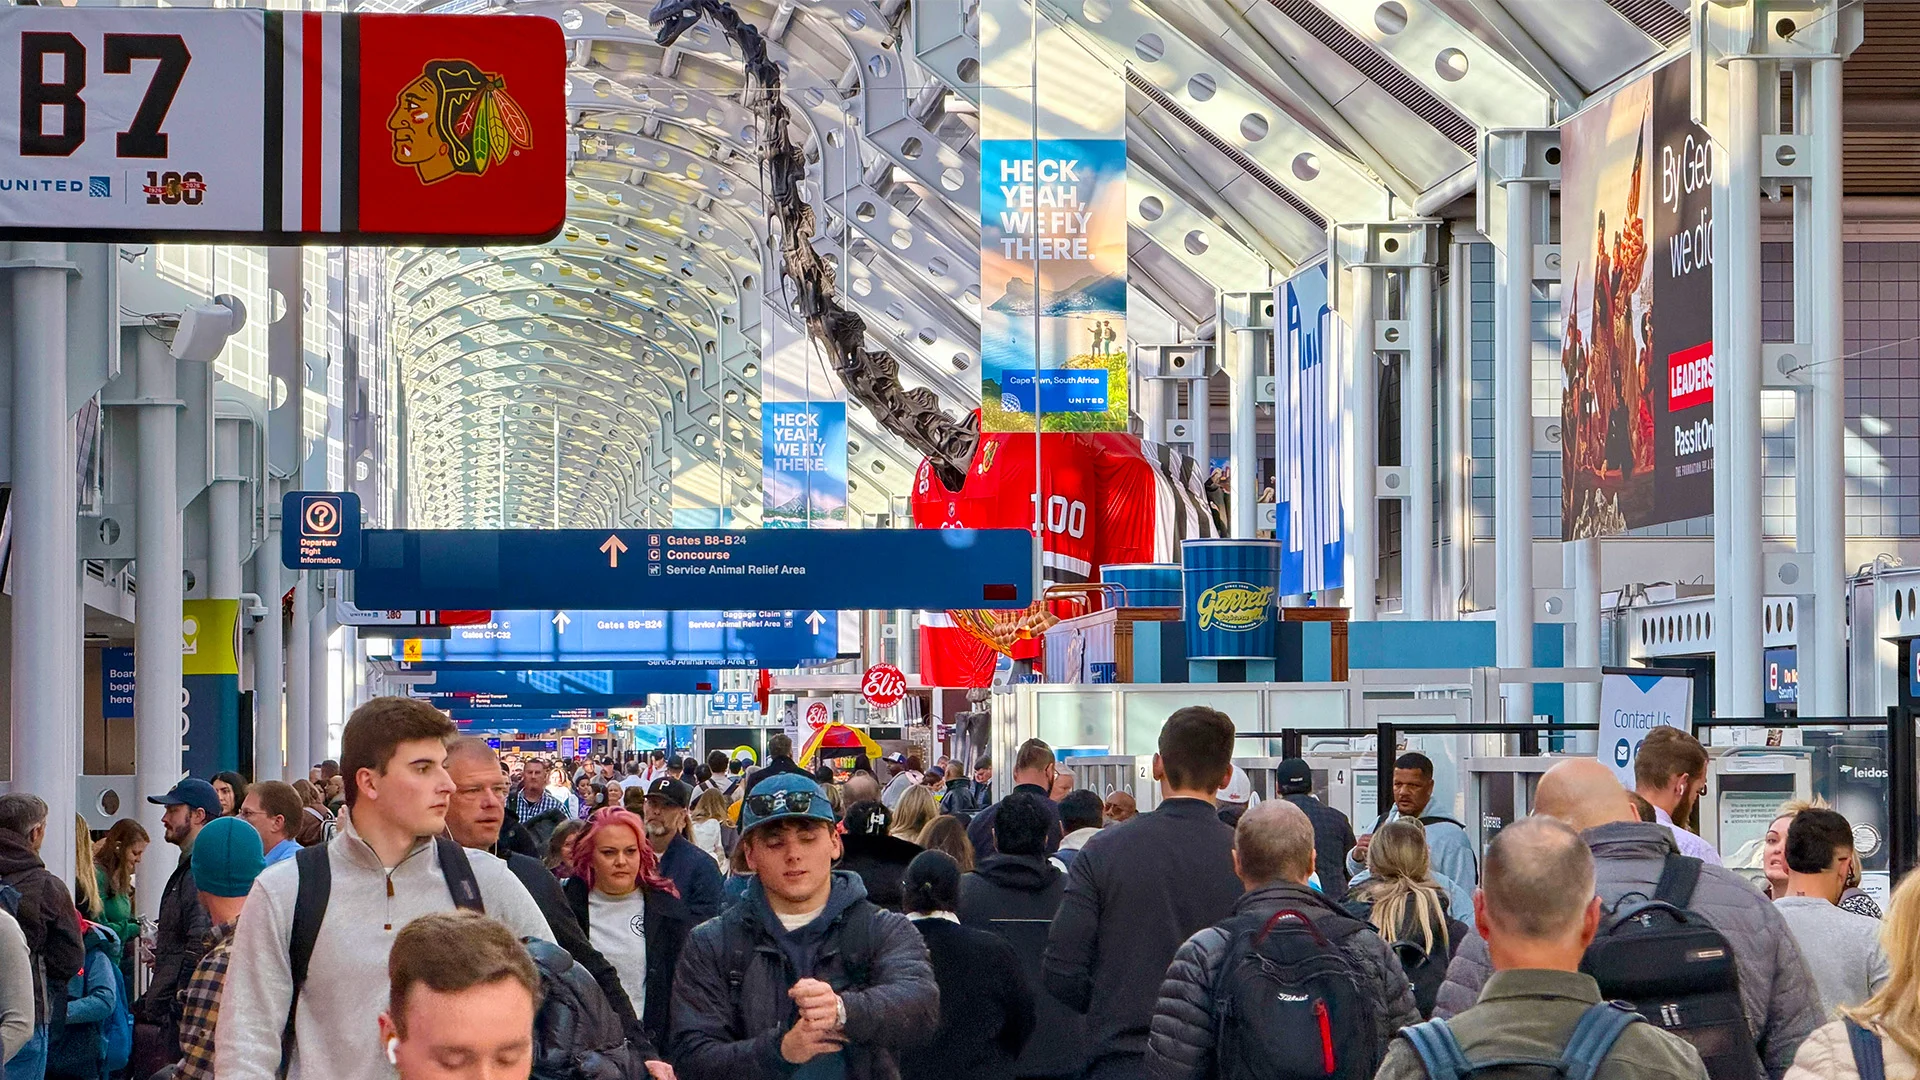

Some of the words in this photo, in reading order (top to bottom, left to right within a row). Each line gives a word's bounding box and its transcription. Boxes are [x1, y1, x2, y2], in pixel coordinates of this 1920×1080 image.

[19, 31, 192, 158] B7
[1000, 159, 1080, 182] HECK
[0, 179, 84, 192] UNITED
[1663, 145, 1681, 213] By
[1000, 185, 1086, 212] YEAH,
[1000, 211, 1045, 234] WE
[1051, 211, 1093, 234] FLY
[1000, 237, 1096, 260] THERE.
[1669, 229, 1692, 278] we
[1010, 376, 1031, 385] Cape
[1031, 377, 1053, 385] Twn,
[1053, 376, 1077, 384] South
[1076, 376, 1100, 384] Africa
[1671, 354, 1714, 398] LEADERS
[773, 413, 819, 427] HECK
[773, 428, 822, 443] YEAH,
[773, 443, 802, 456] WE
[802, 443, 827, 456] FLY
[773, 458, 829, 471] THERE.
[300, 538, 337, 547] Departure
[667, 535, 701, 545] Gates
[704, 535, 747, 545] B8-B24
[300, 547, 321, 556] Flight
[667, 549, 731, 560] Concourse
[300, 556, 341, 564] Information
[666, 564, 706, 575] Service
[708, 564, 745, 575] Animal
[747, 564, 779, 575] Relief
[780, 564, 806, 575] Area
[723, 610, 757, 619] Baggage
[1197, 586, 1274, 631] Garrett
[597, 620, 625, 629] Gates
[628, 620, 662, 629] B9-B24
[688, 620, 716, 629] Service
[716, 620, 742, 628] Animal
[863, 672, 905, 696] Eli's
[110, 694, 132, 704] here
[1614, 708, 1654, 730] Contact
[1658, 711, 1671, 727] Us
[1140, 766, 1146, 778] 2
[1337, 770, 1344, 784] 4
[1854, 766, 1889, 778] leidos
[659, 780, 670, 790] P
